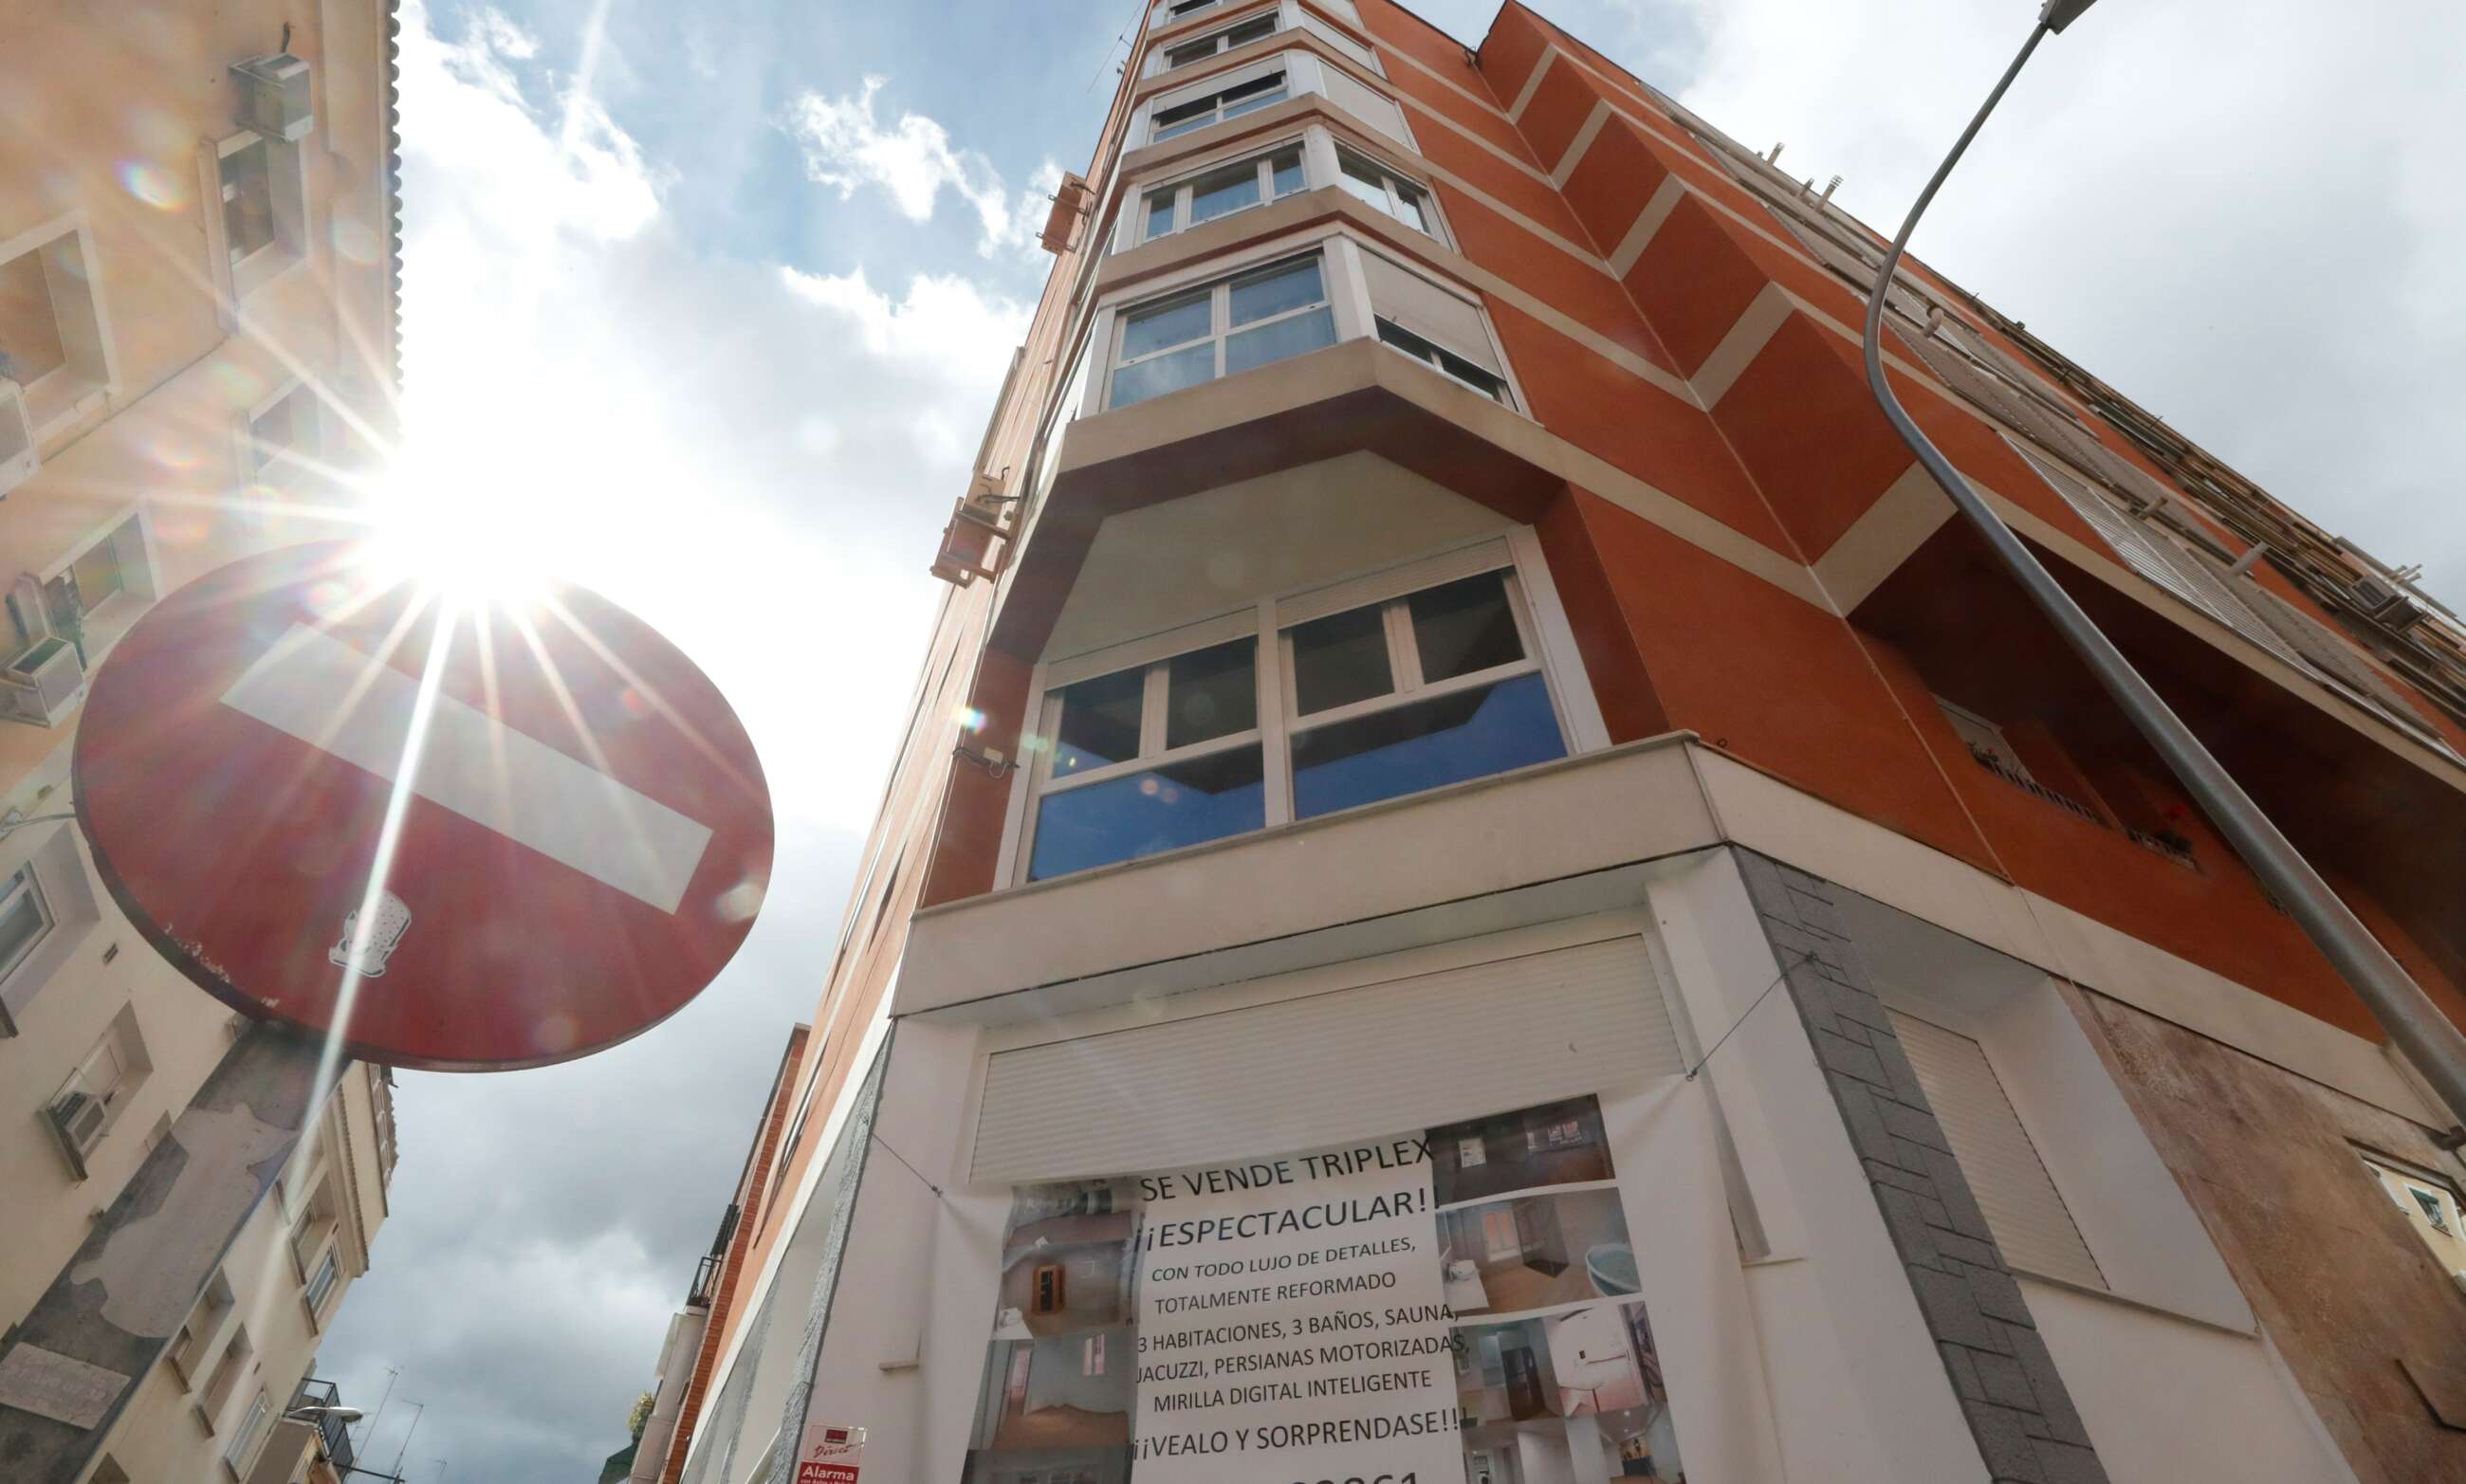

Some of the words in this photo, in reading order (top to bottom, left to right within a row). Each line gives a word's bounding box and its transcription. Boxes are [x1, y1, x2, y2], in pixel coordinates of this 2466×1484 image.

[1140, 1176, 1176, 1201] SE
[1182, 1161, 1294, 1196] VENDE
[1299, 1137, 1434, 1180] TRIPLEX
[1151, 1267, 1189, 1281] CON
[1194, 1260, 1244, 1277] TODO
[1249, 1255, 1292, 1273] LUJO
[1297, 1251, 1319, 1267] DE
[1325, 1237, 1416, 1262] DETALLES,
[1154, 1287, 1271, 1314] TOTALMENTE
[1277, 1272, 1396, 1299] REFORMADO
[1138, 1337, 1148, 1353] 3
[1152, 1321, 1286, 1351] HABITACIONES,
[1292, 1319, 1303, 1335] 3
[1309, 1310, 1379, 1334] BAÑOS,
[1385, 1304, 1460, 1326] SAUNA,
[1136, 1361, 1209, 1383] JACUZZI,
[1215, 1348, 1314, 1374] PERSIANAS
[1319, 1334, 1470, 1364] MOTORIZADAS,
[1154, 1390, 1224, 1412] MIRILLA
[1230, 1382, 1302, 1404] DIGITAL
[1308, 1370, 1432, 1397] INTELIGENTE
[1236, 1429, 1249, 1451] Y
[802, 1466, 855, 1481] Alarma
